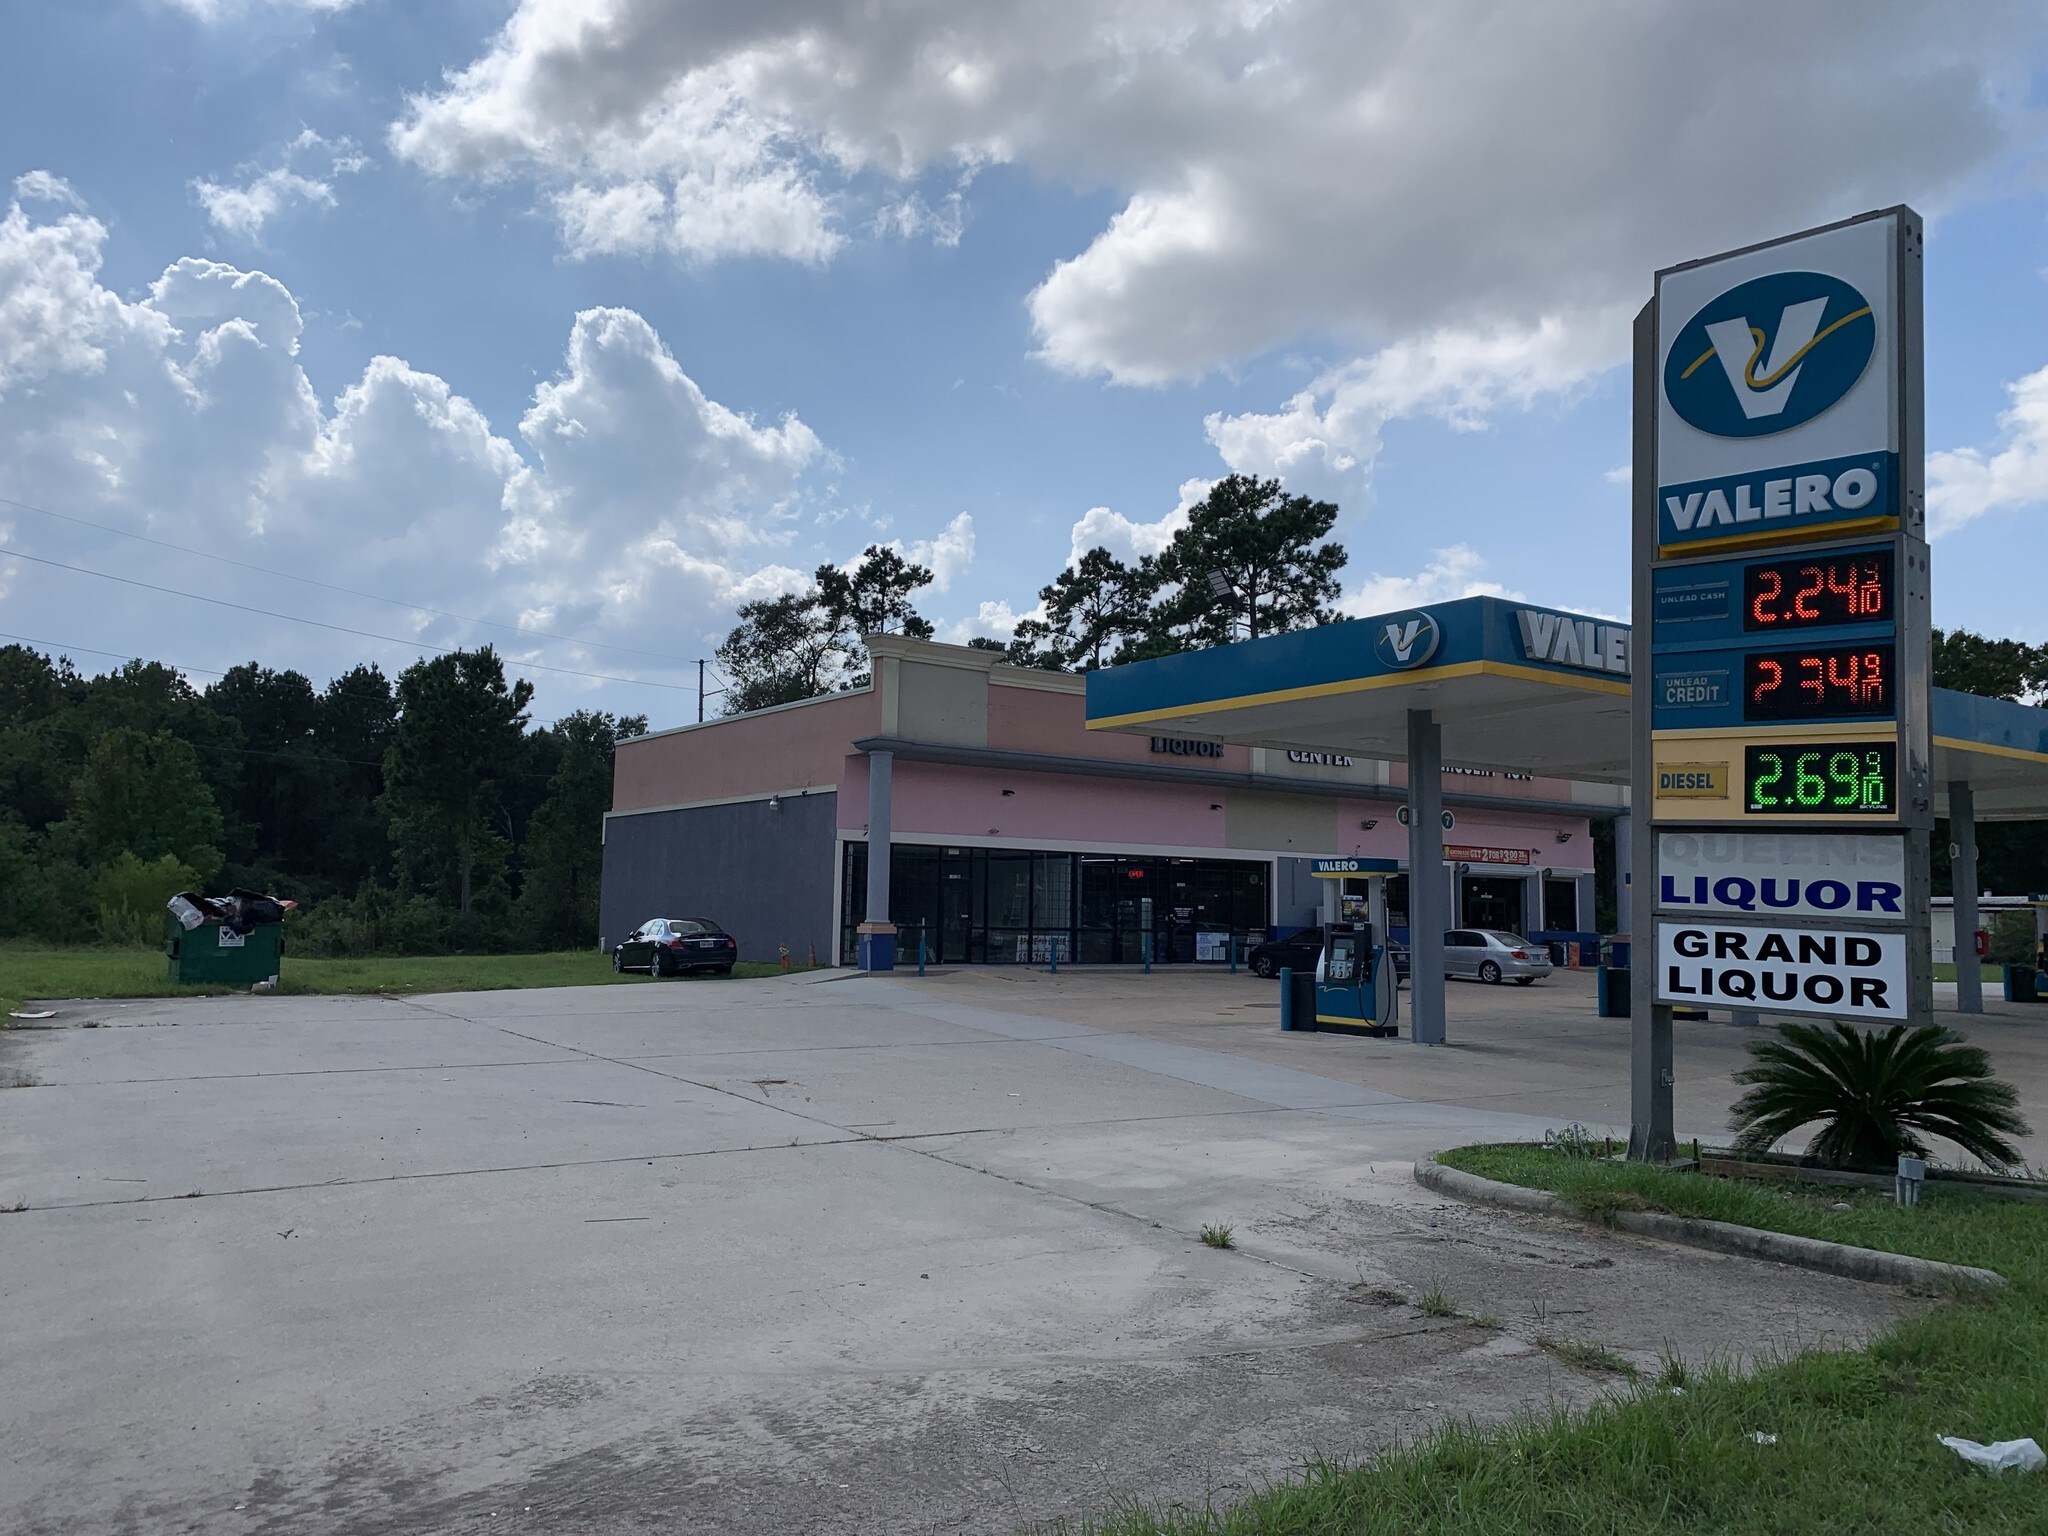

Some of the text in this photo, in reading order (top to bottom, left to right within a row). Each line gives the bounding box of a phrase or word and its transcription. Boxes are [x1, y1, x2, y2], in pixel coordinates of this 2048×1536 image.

[1666, 468, 1878, 531] VALERO
[1661, 592, 1725, 603] UNLEAD CASH
[1516, 609, 1632, 675] VALE
[1667, 677, 1708, 687] UNLEAD
[1667, 686, 1719, 703] CREDIT
[1151, 736, 1224, 758] LIQUOR
[1660, 773, 1714, 789] DIESEL
[1444, 815, 1451, 826] 7
[1470, 850, 1481, 858] GET
[1482, 848, 1488, 861] 2
[1489, 850, 1500, 859] FOR
[1661, 834, 1902, 867] QUEENS
[1319, 861, 1358, 871] VALERO
[1661, 875, 1902, 912] LIQUOR
[1673, 930, 1882, 967] GRAND
[1669, 966, 1891, 1009] LIQUOR
